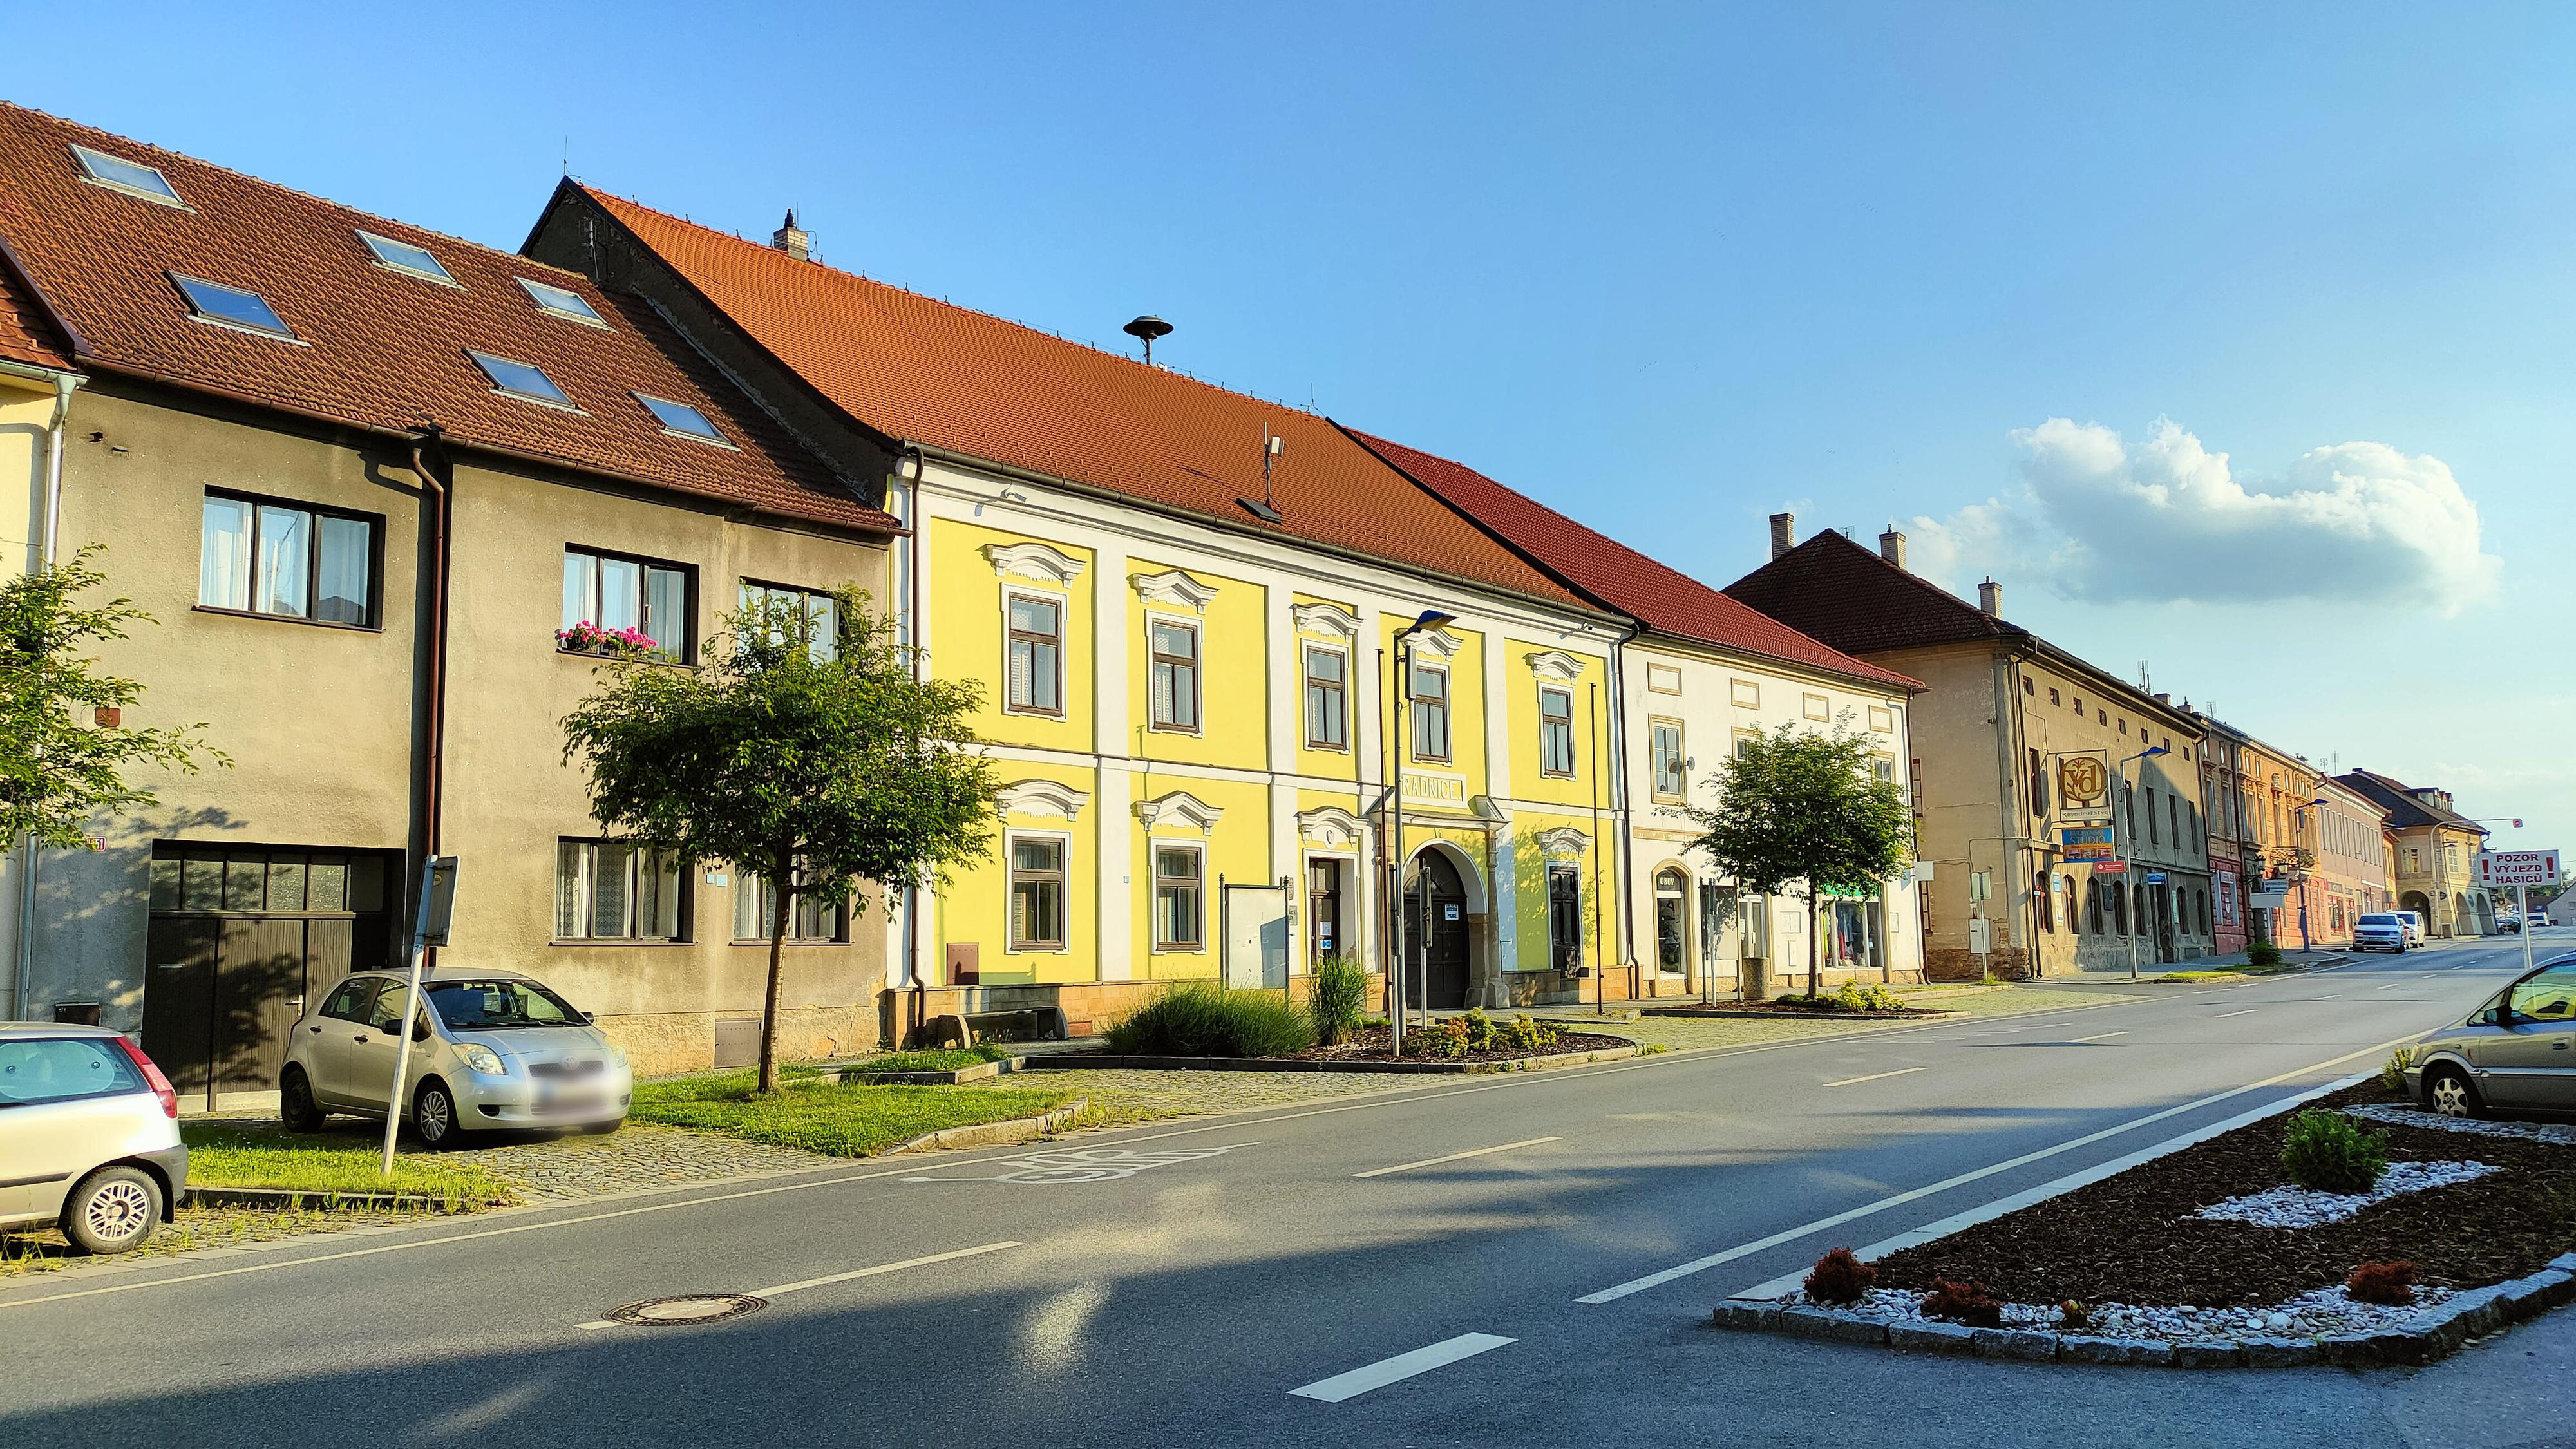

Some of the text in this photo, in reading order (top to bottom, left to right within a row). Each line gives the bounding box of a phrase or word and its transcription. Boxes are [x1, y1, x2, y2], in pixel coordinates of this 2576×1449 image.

[2070, 835, 2105, 845] STUDIO
[2496, 854, 2539, 862] POZOR
[2494, 864, 2542, 873] VÝJEZD
[2496, 873, 2543, 884] HASIČŮ
